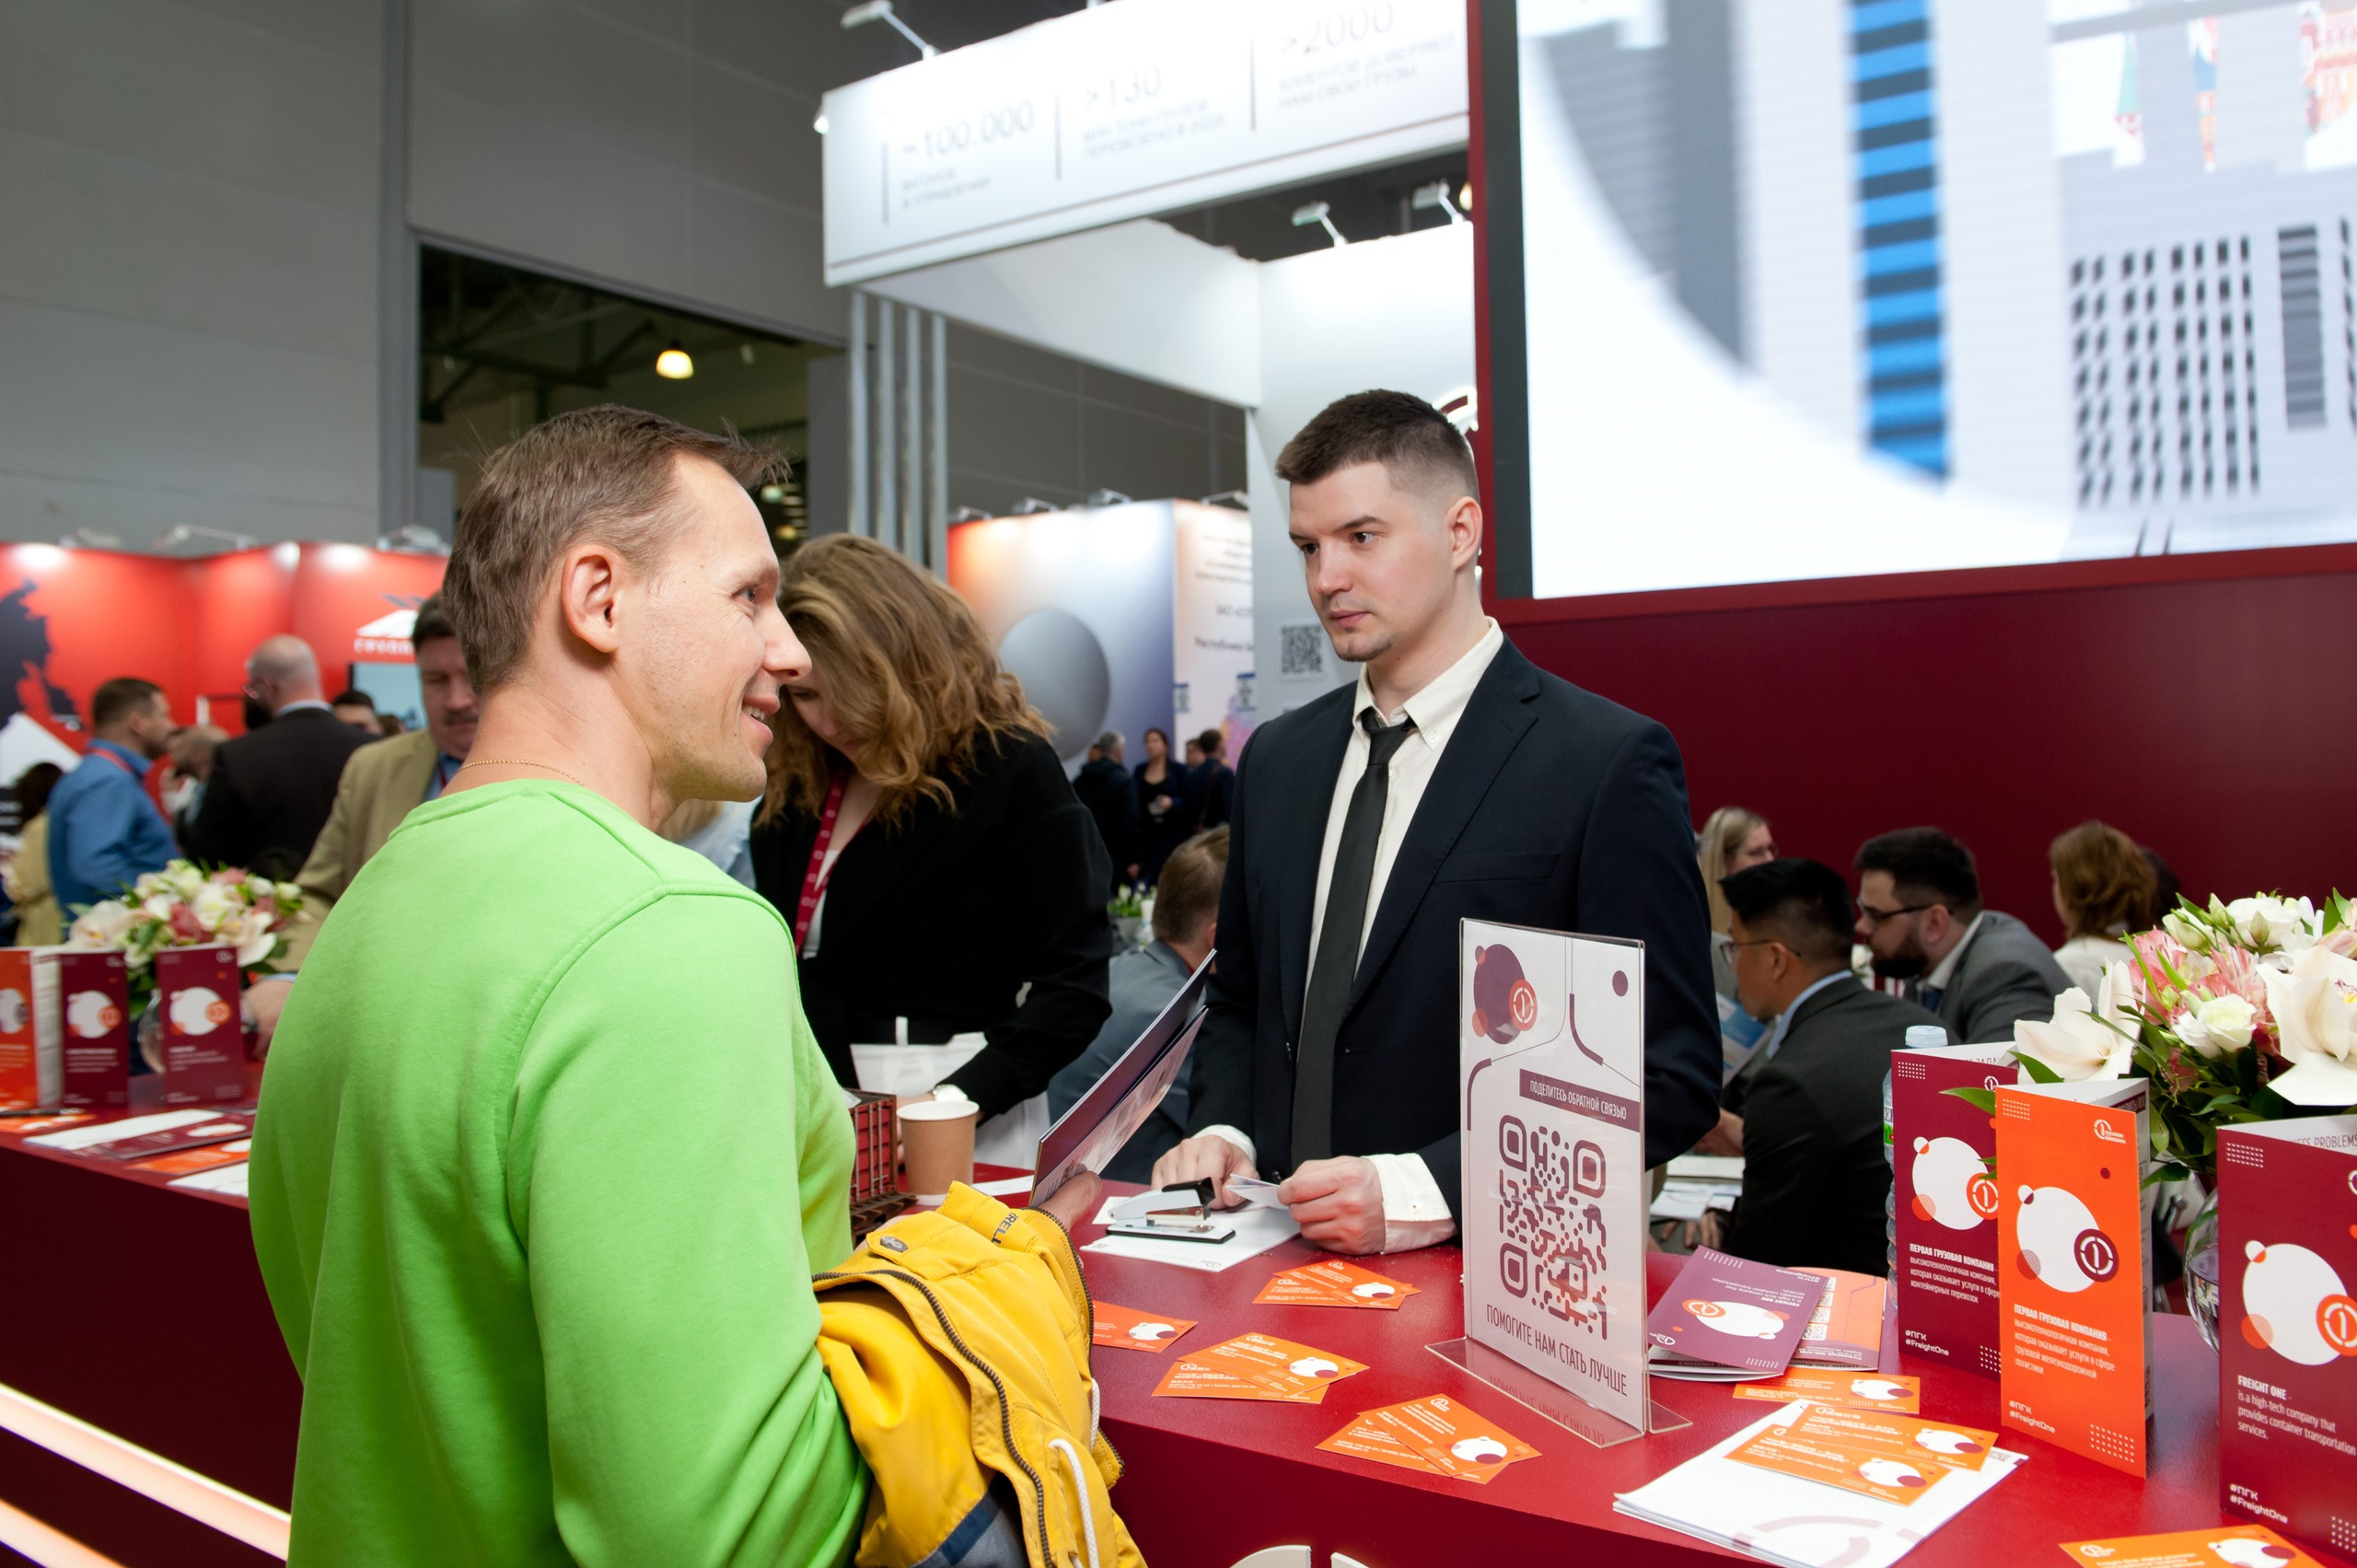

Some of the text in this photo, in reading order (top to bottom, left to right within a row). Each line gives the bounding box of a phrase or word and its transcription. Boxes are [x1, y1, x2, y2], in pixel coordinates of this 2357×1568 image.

[1529, 1080, 1627, 1121] ПОДЕЛИТЕСЬ ОБРАТНОЙ СВЯЗЬЮ
[1910, 1243, 1994, 1272] ПЕРВАЯ ГРУЗОВАЯ КОМПАНИЯ
[1910, 1256, 1969, 1277] высокотехнологичная
[1910, 1268, 1932, 1280] которая
[1933, 1273, 1960, 1286] оказывает
[1961, 1281, 1980, 1293] услуги
[1910, 1280, 1979, 1304] контейнерных перевозок
[1774, 1298, 1801, 1307] FREIGHT
[2014, 1303, 2107, 1342] ПЕРВАЯ ГРУЗОВАЯ КОМПАНИЯ
[1905, 1330, 1927, 1342] #ПГК
[1905, 1339, 1950, 1356] #FreightOne
[1486, 1304, 1628, 1397] ПОМОГИТЕ НАМ СТАТЬ ЛУЧШЕ
[2238, 1375, 2287, 1400] FREIGHT ONE
[2009, 1400, 2032, 1414] #ПГК
[2238, 1389, 2336, 1433] is a high-tech company that
[2009, 1410, 2056, 1434] #FreightOne
[2237, 1422, 2269, 1440] services.
[2237, 1407, 2357, 1456] provides container transportation
[2230, 1483, 2258, 1501] #ПГК
[2230, 1494, 2289, 1524] #FreightOne
